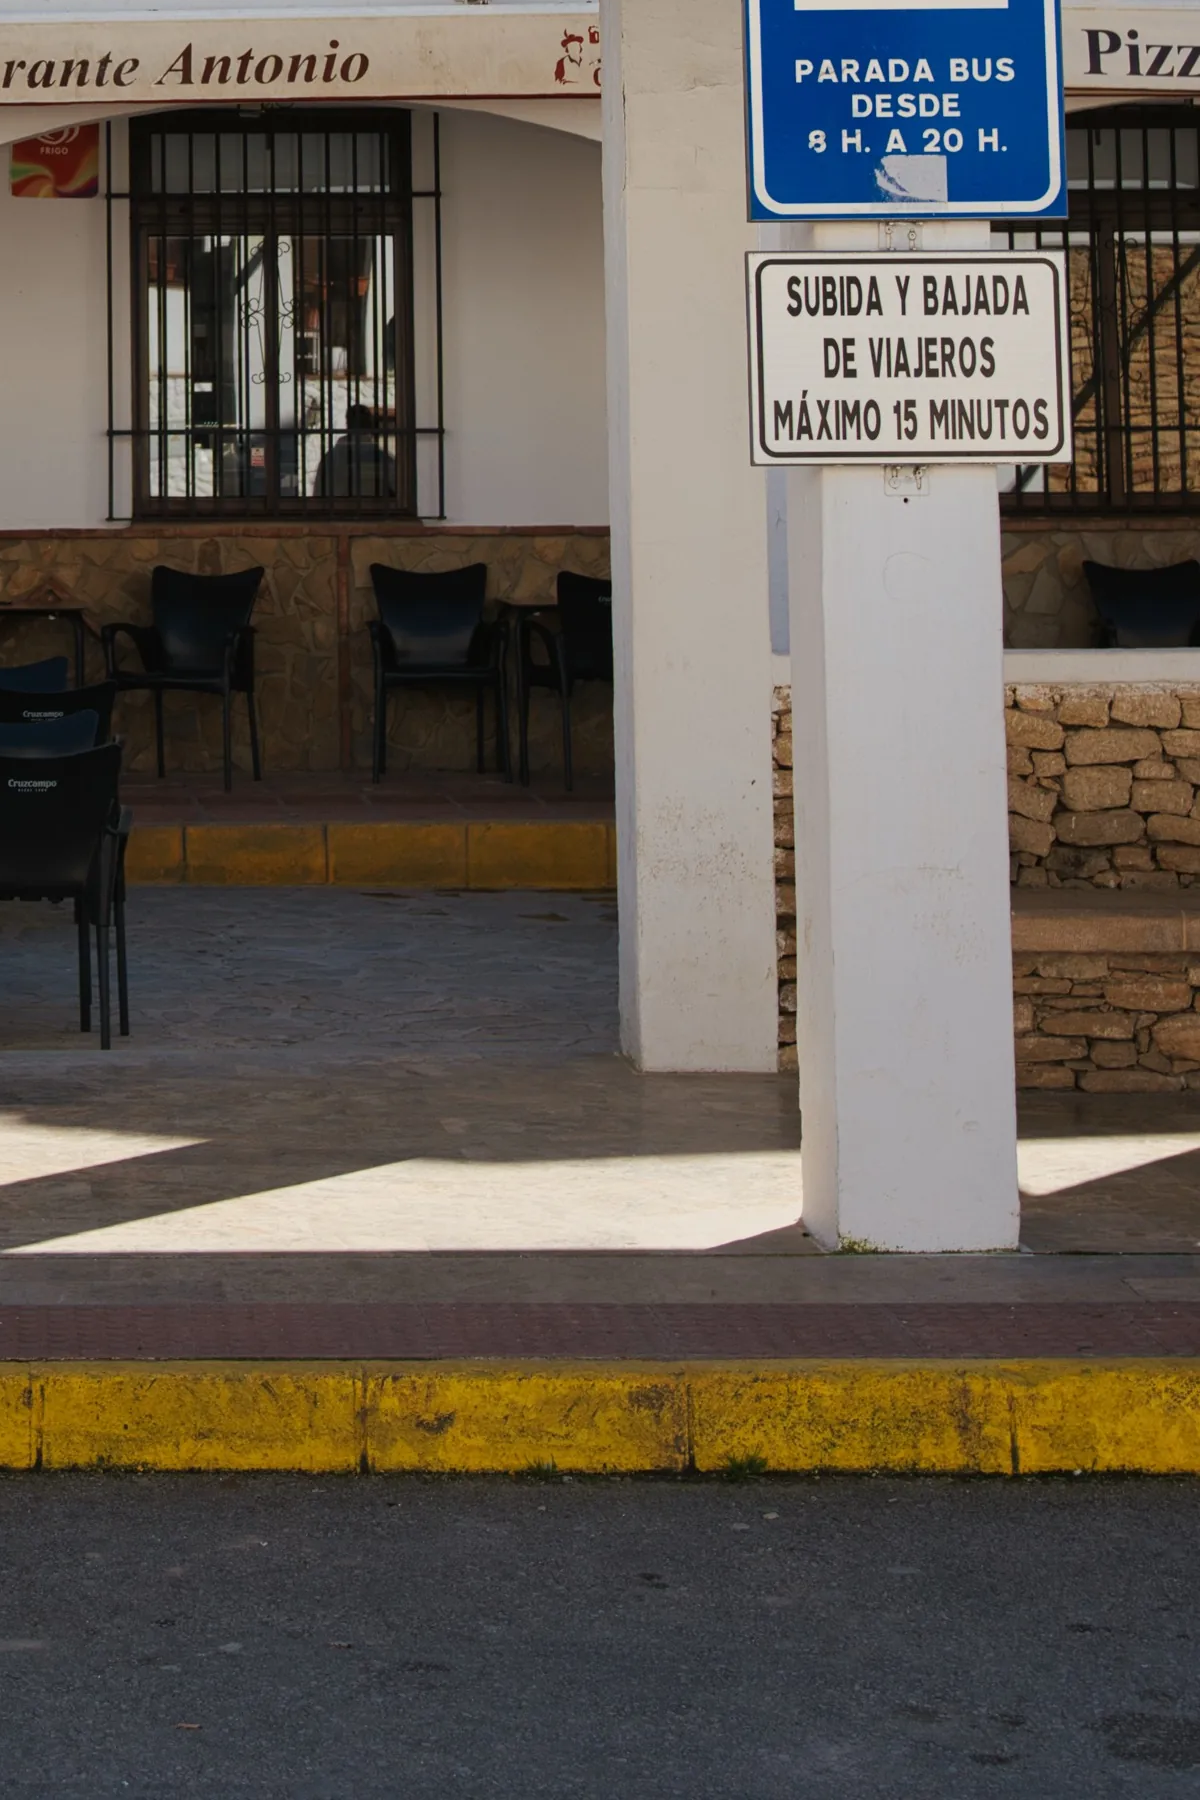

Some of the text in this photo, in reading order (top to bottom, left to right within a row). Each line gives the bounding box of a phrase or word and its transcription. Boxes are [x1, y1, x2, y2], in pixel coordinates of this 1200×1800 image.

[155, 39, 370, 87] Antonio
[1081, 29, 1200, 77] Pizz
[795, 58, 1015, 83] PARADA BUS
[852, 94, 960, 118] DESDE
[40, 146, 68, 156] FRIGO
[809, 128, 1008, 153] 8 H. A 20 H.
[786, 275, 1030, 317] SUBIDA Y BAJADA
[824, 336, 996, 378] DE VIAJEROS
[774, 390, 1049, 440] MÁXIMO 15 MINUTOS
[7, 778, 58, 788] Cruzcampo
